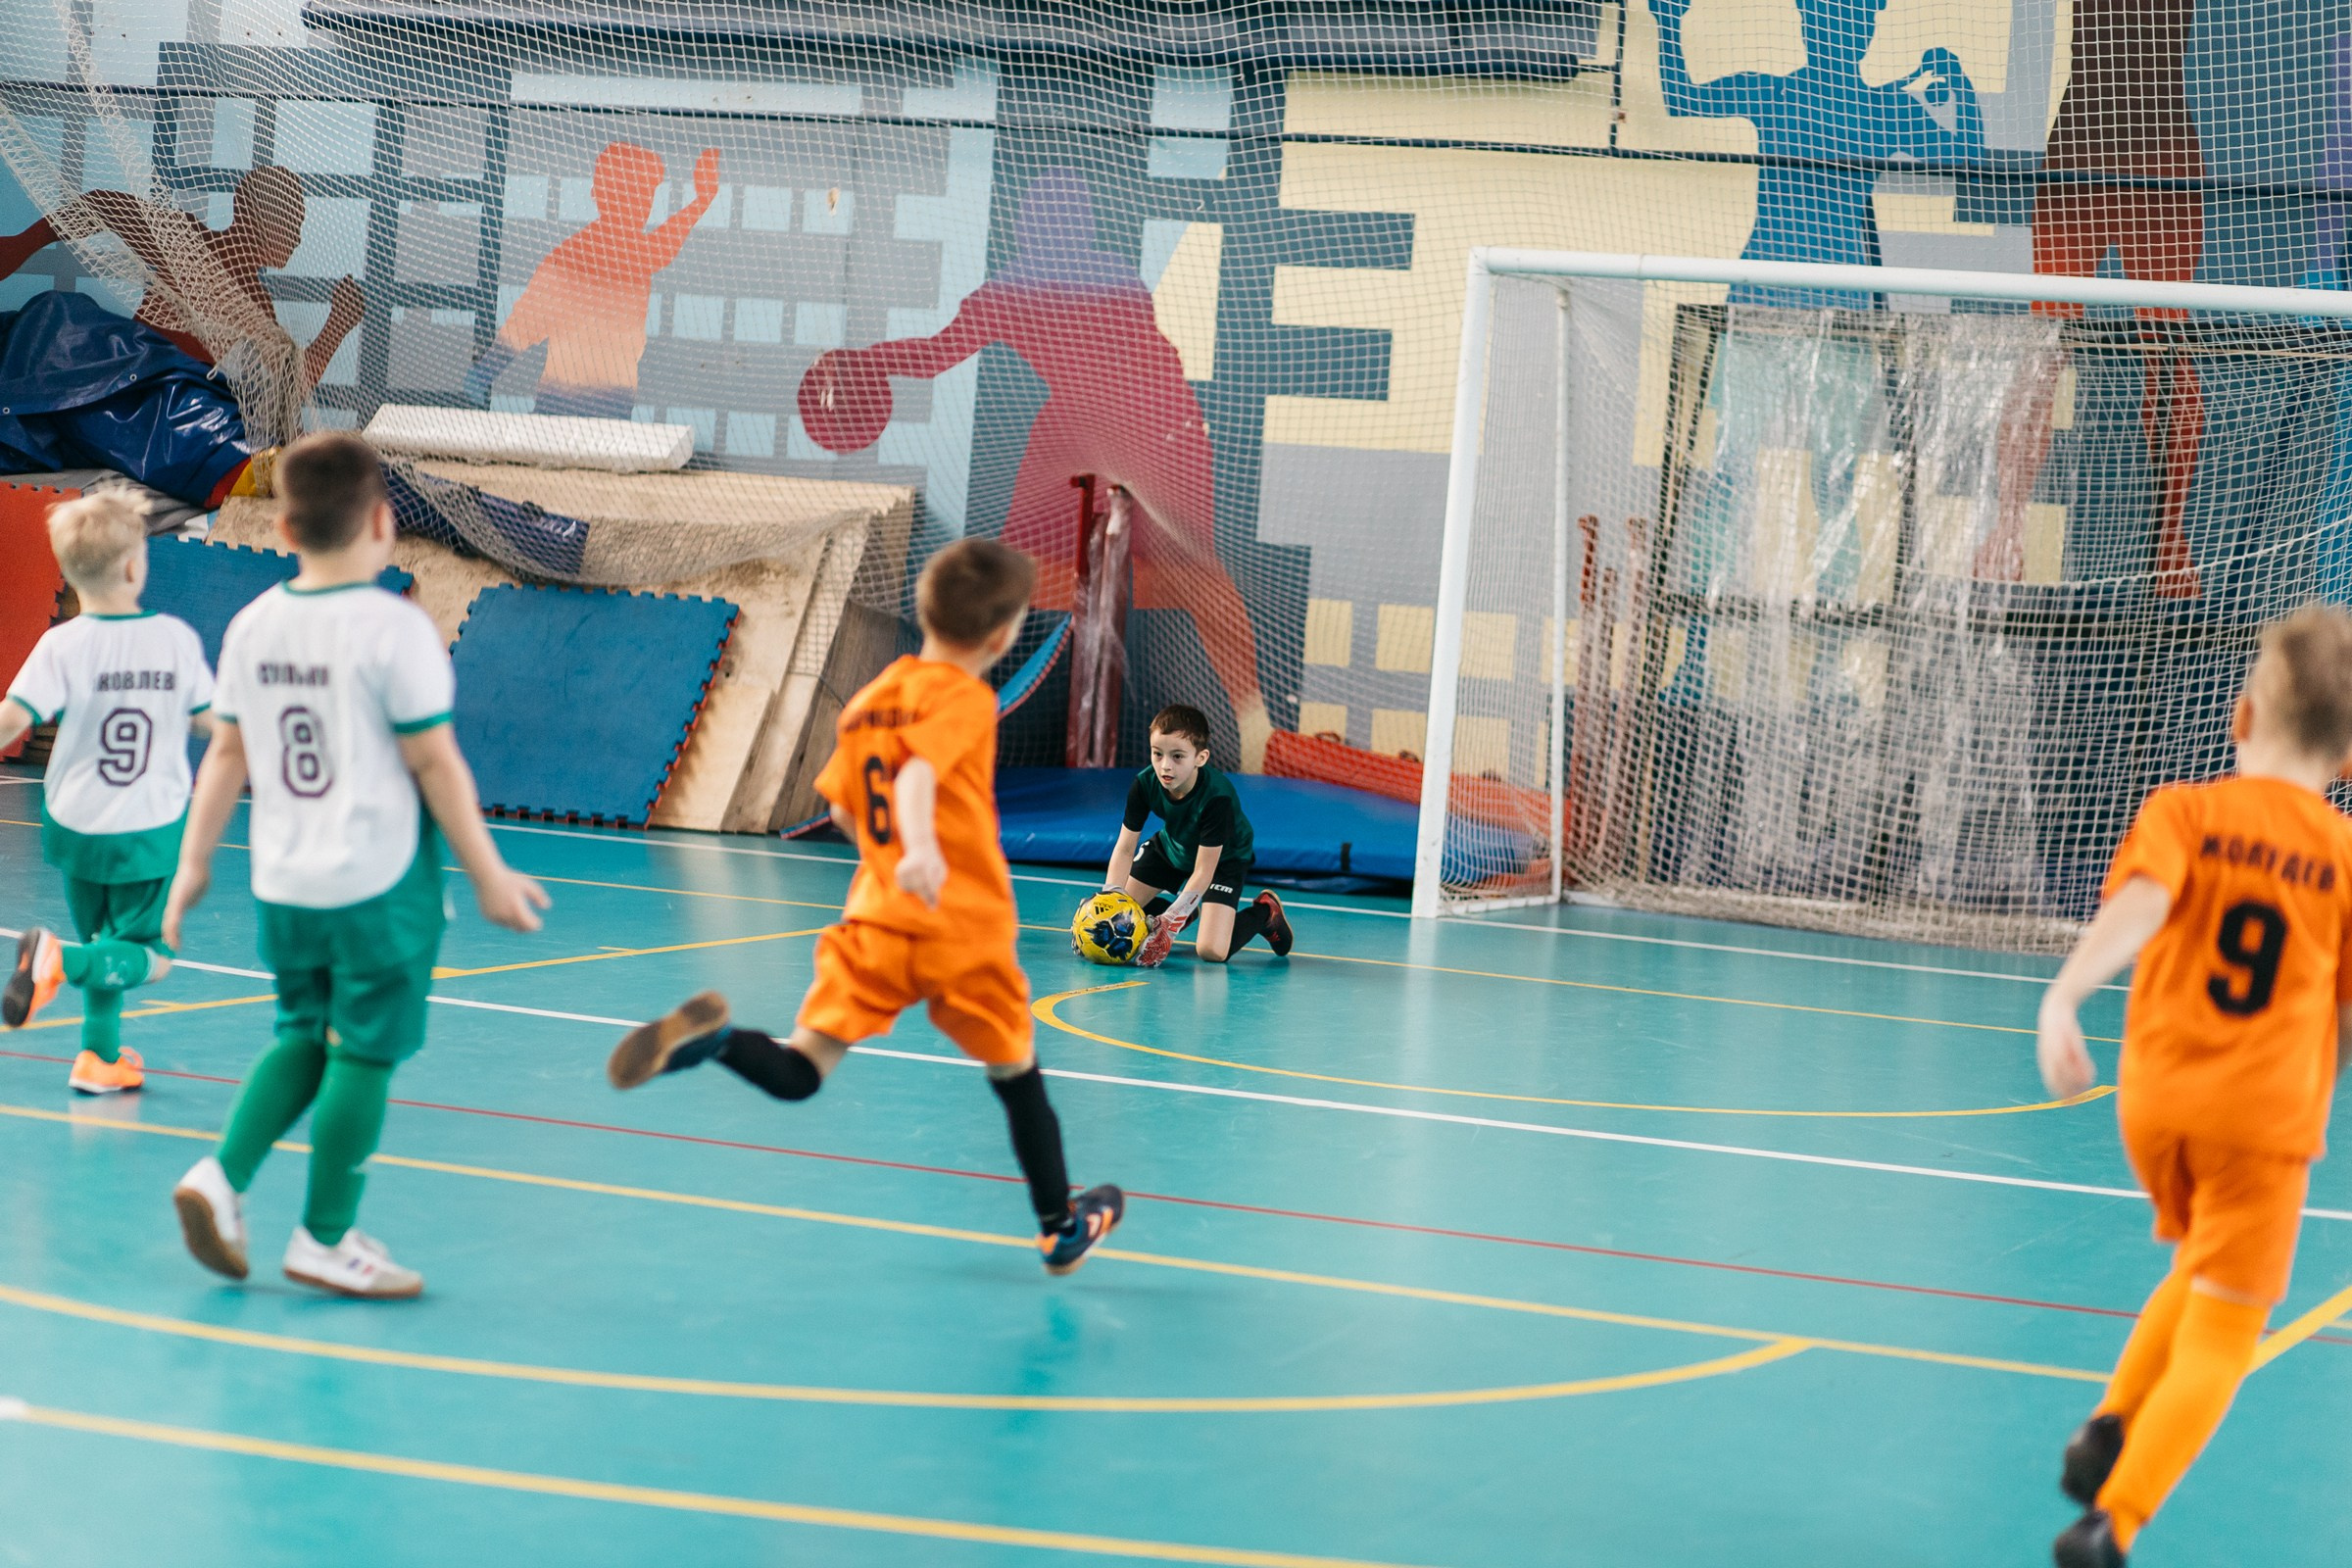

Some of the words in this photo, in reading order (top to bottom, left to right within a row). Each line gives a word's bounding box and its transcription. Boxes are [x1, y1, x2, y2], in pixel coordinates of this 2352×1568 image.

[99, 707, 153, 787] 9
[278, 705, 336, 799] 8
[862, 755, 896, 846] 6
[2208, 899, 2288, 1018] 9
